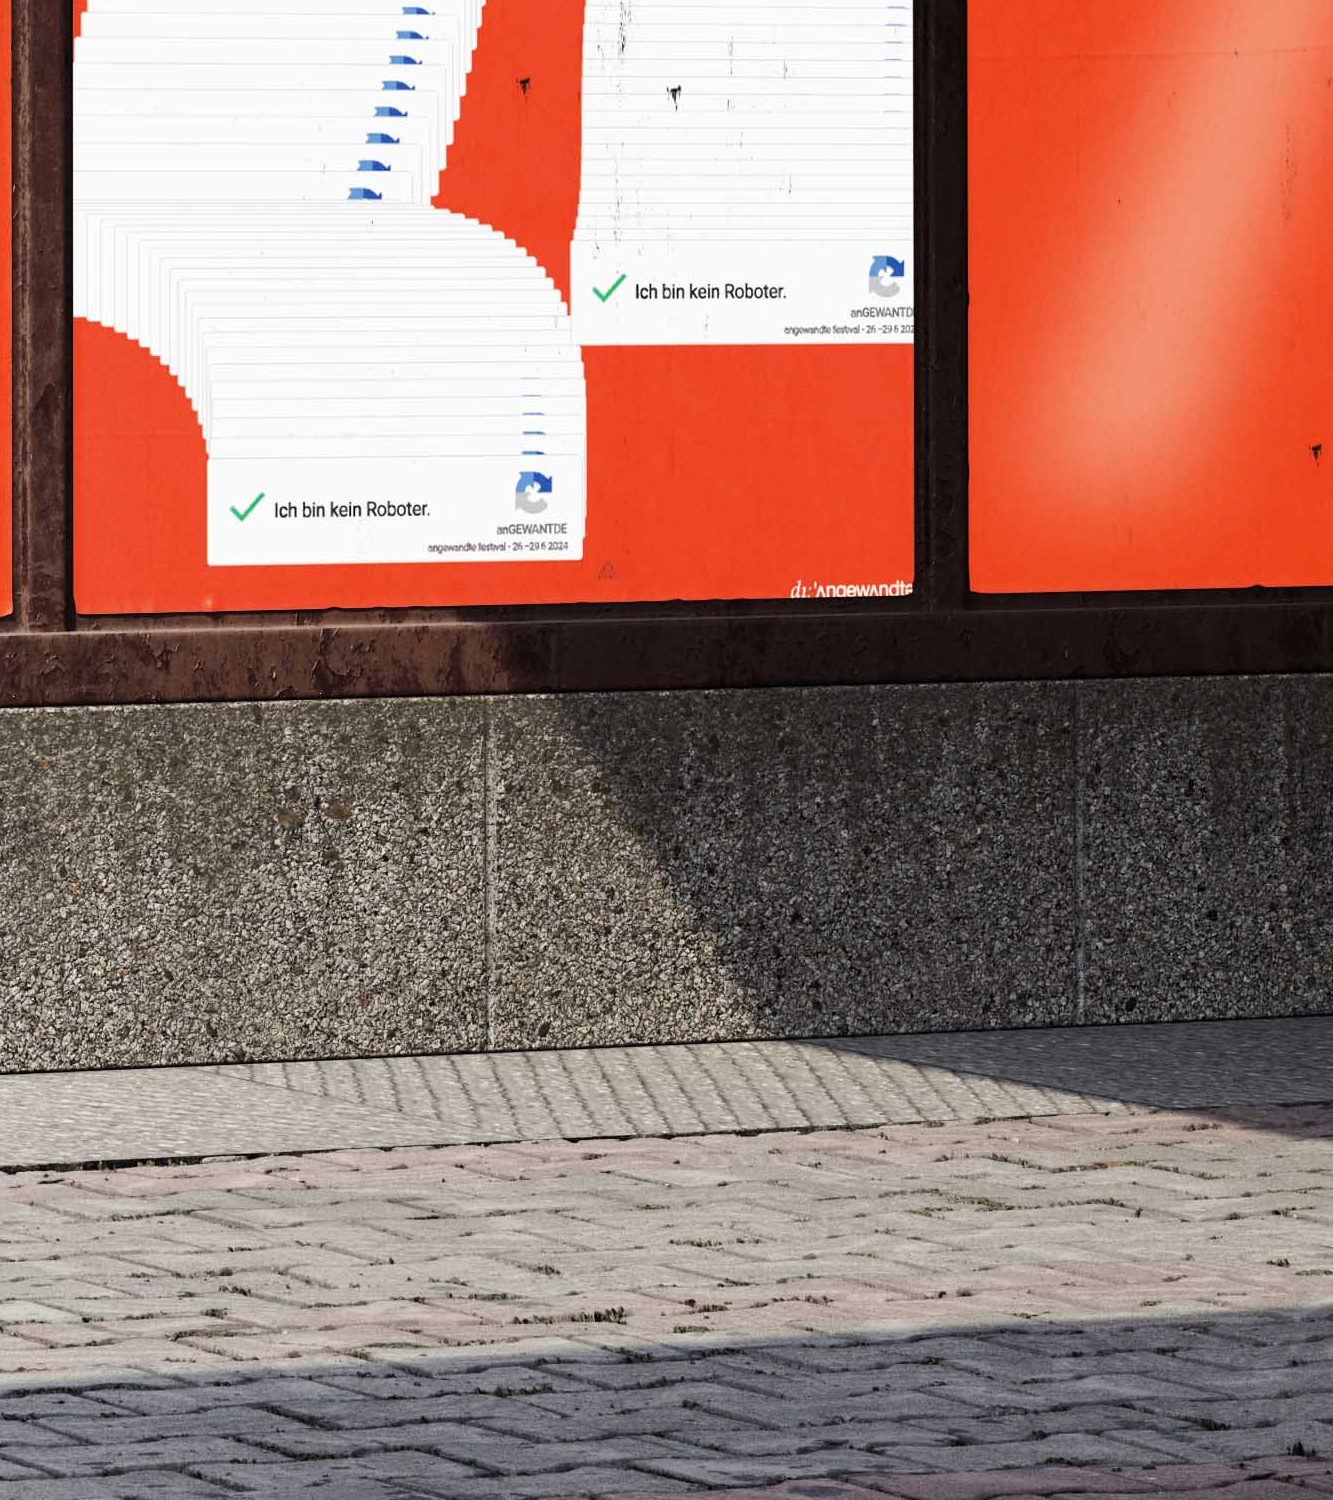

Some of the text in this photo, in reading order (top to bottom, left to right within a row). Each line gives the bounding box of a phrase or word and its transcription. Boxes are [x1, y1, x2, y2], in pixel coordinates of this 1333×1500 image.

[635, 283, 787, 300] Ich bin kein Roboter.
[783, 325, 832, 337] angewandte
[274, 501, 430, 519] Ich bin kein Roboter.
[496, 524, 568, 535] anGEWANTDE
[427, 543, 477, 555] angewandte
